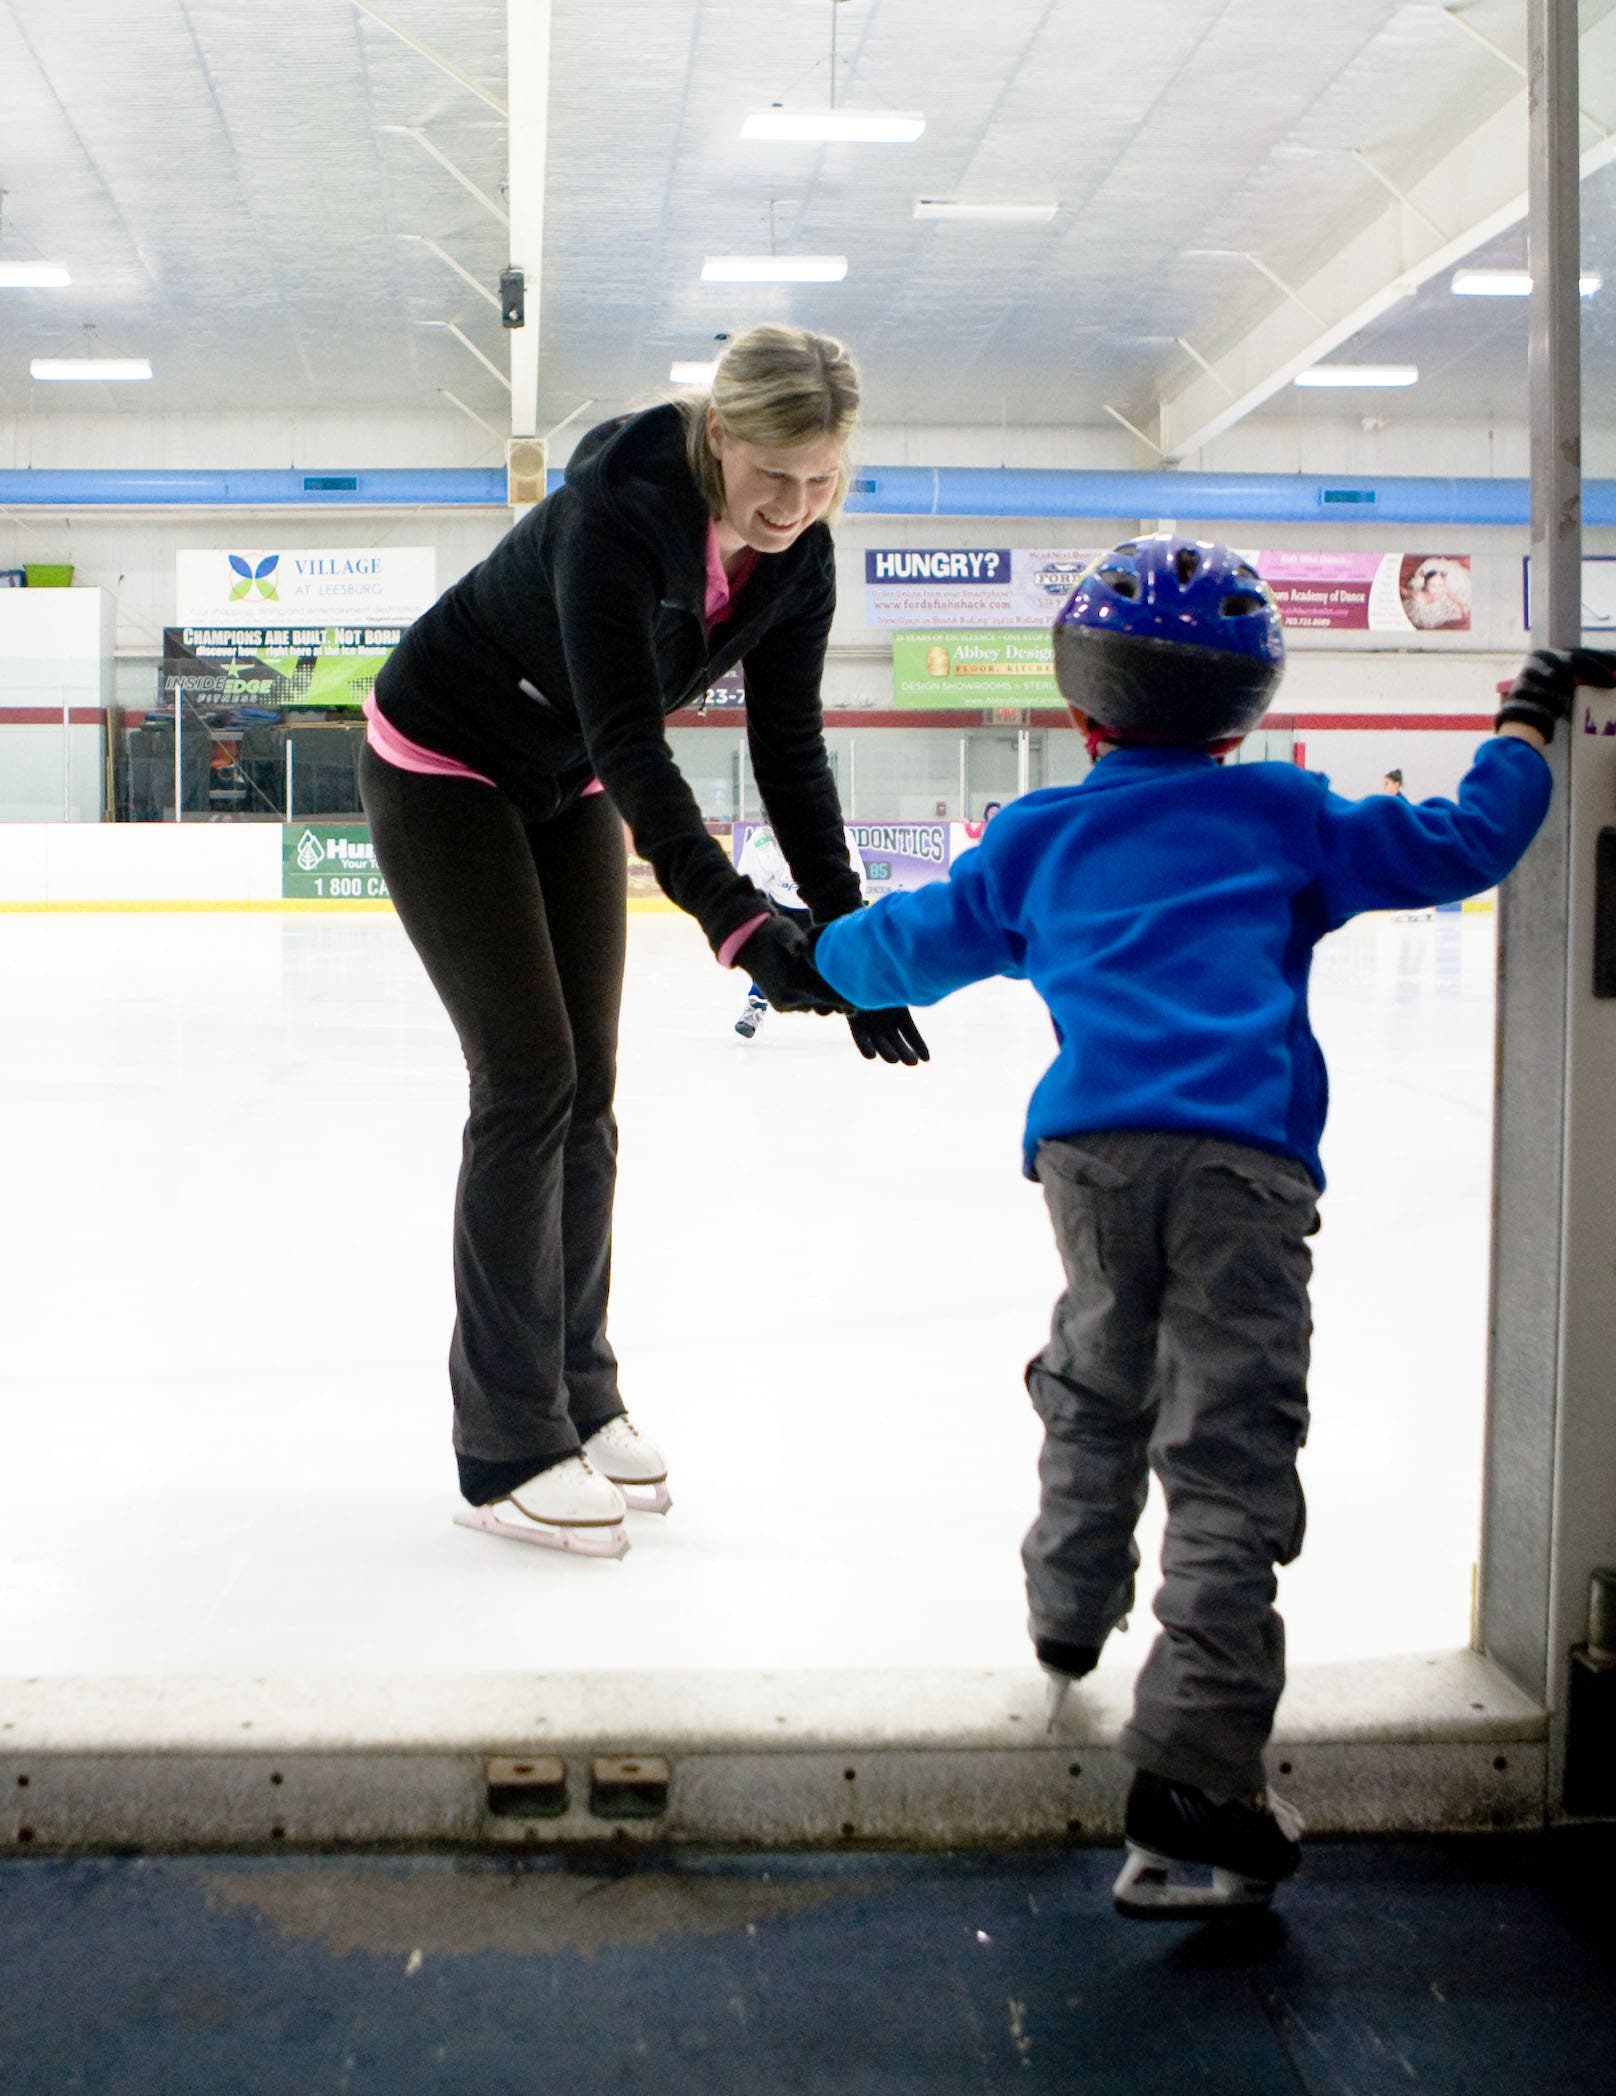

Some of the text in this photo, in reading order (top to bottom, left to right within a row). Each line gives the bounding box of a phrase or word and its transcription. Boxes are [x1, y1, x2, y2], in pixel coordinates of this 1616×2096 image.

[295, 558, 382, 576] VILLAGE
[876, 552, 1000, 578] HUNGRY?
[295, 583, 383, 597] AT LEESBURG
[1291, 588, 1328, 605] Academy
[1330, 589, 1339, 602] of
[1340, 589, 1365, 603] Dance
[183, 628, 262, 646] CHAMPIONS
[265, 629, 290, 646] ARE
[334, 628, 362, 646] NOT
[364, 629, 401, 646] BORN
[196, 647, 238, 657] discover
[266, 647, 288, 657] right
[290, 647, 312, 657] here
[325, 647, 339, 657] the
[953, 645, 1000, 662] Abbey
[165, 675, 273, 694] INSIDE EDGE
[901, 681, 940, 691] DESIGN
[943, 681, 1011, 691] SHOWROOMS
[197, 693, 259, 704] FITNESS
[341, 859, 368, 869] Your
[314, 878, 323, 896] 1
[329, 878, 362, 897] 800
